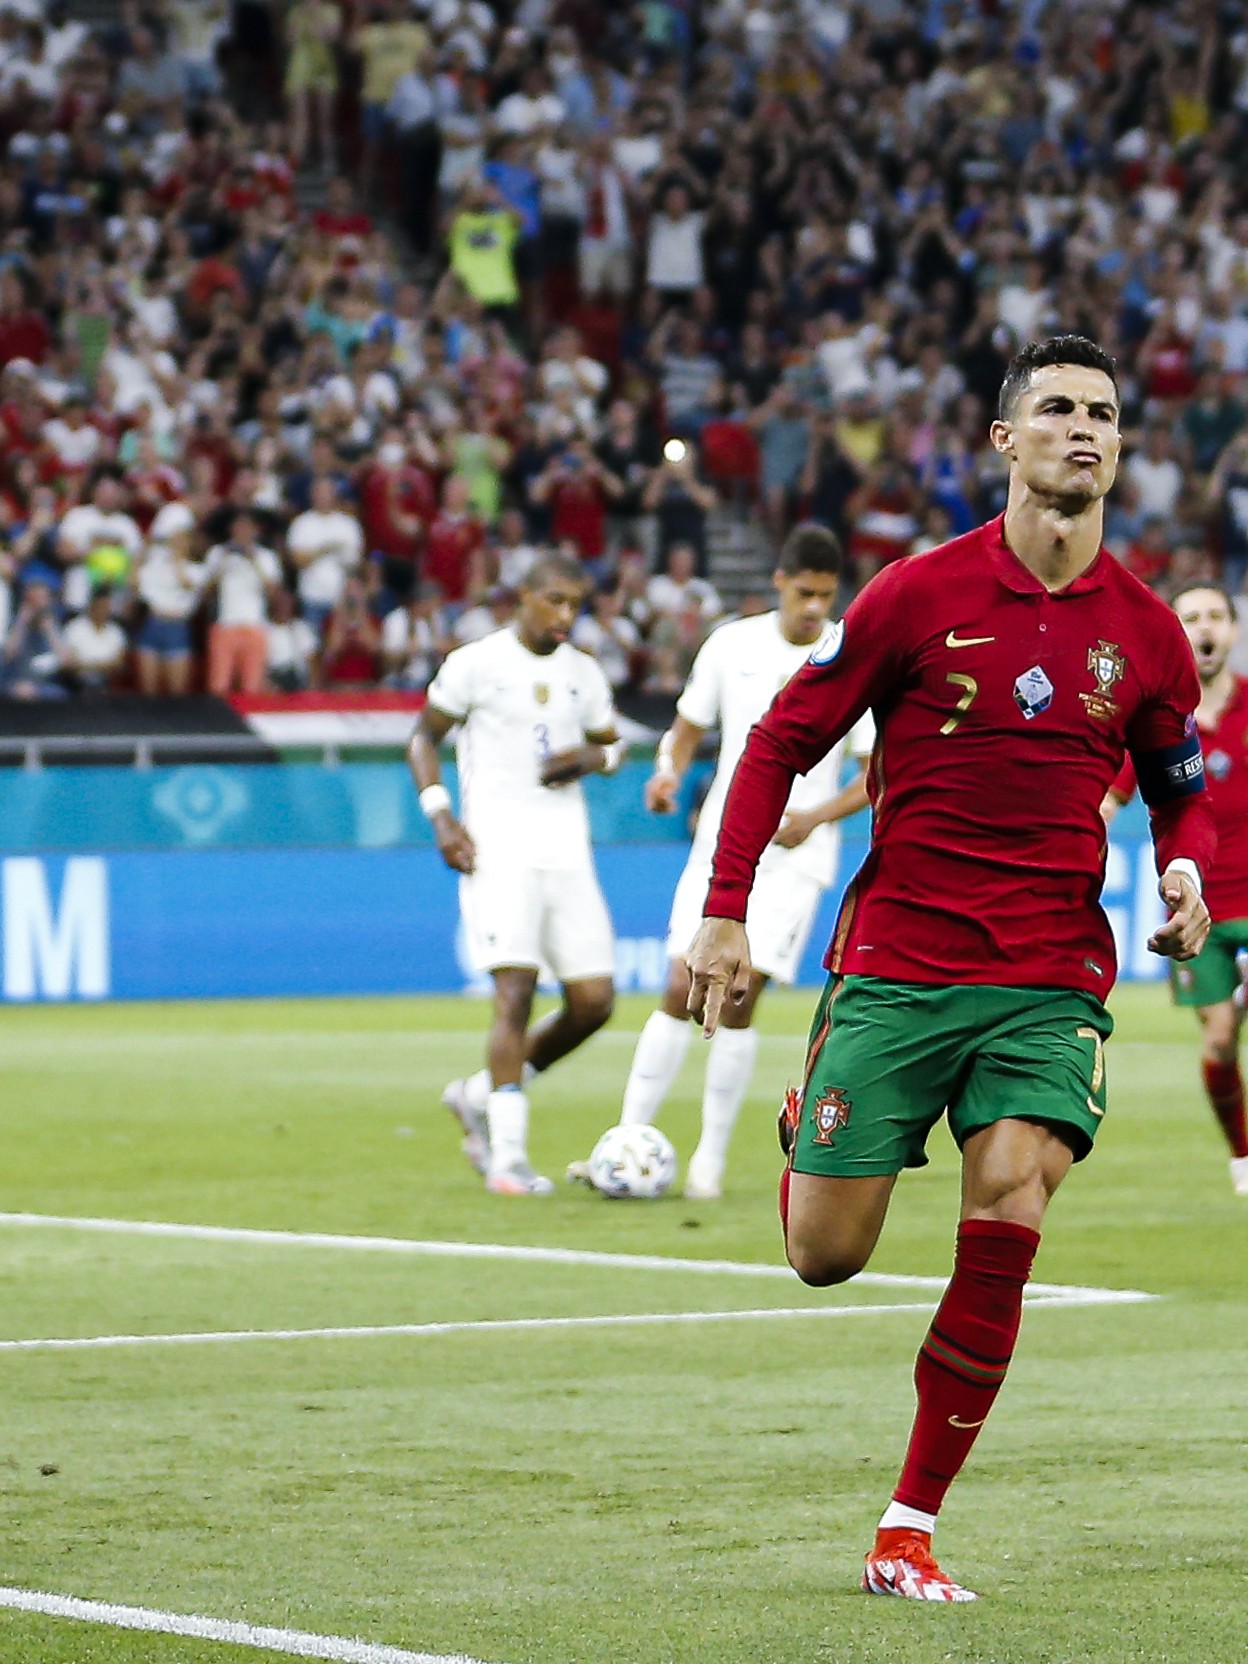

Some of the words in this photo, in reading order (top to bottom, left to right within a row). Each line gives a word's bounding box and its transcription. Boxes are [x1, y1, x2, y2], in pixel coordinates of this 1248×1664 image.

[940, 672, 977, 735] 7
[533, 723, 550, 757] 3
[1076, 1027, 1103, 1093] 7
